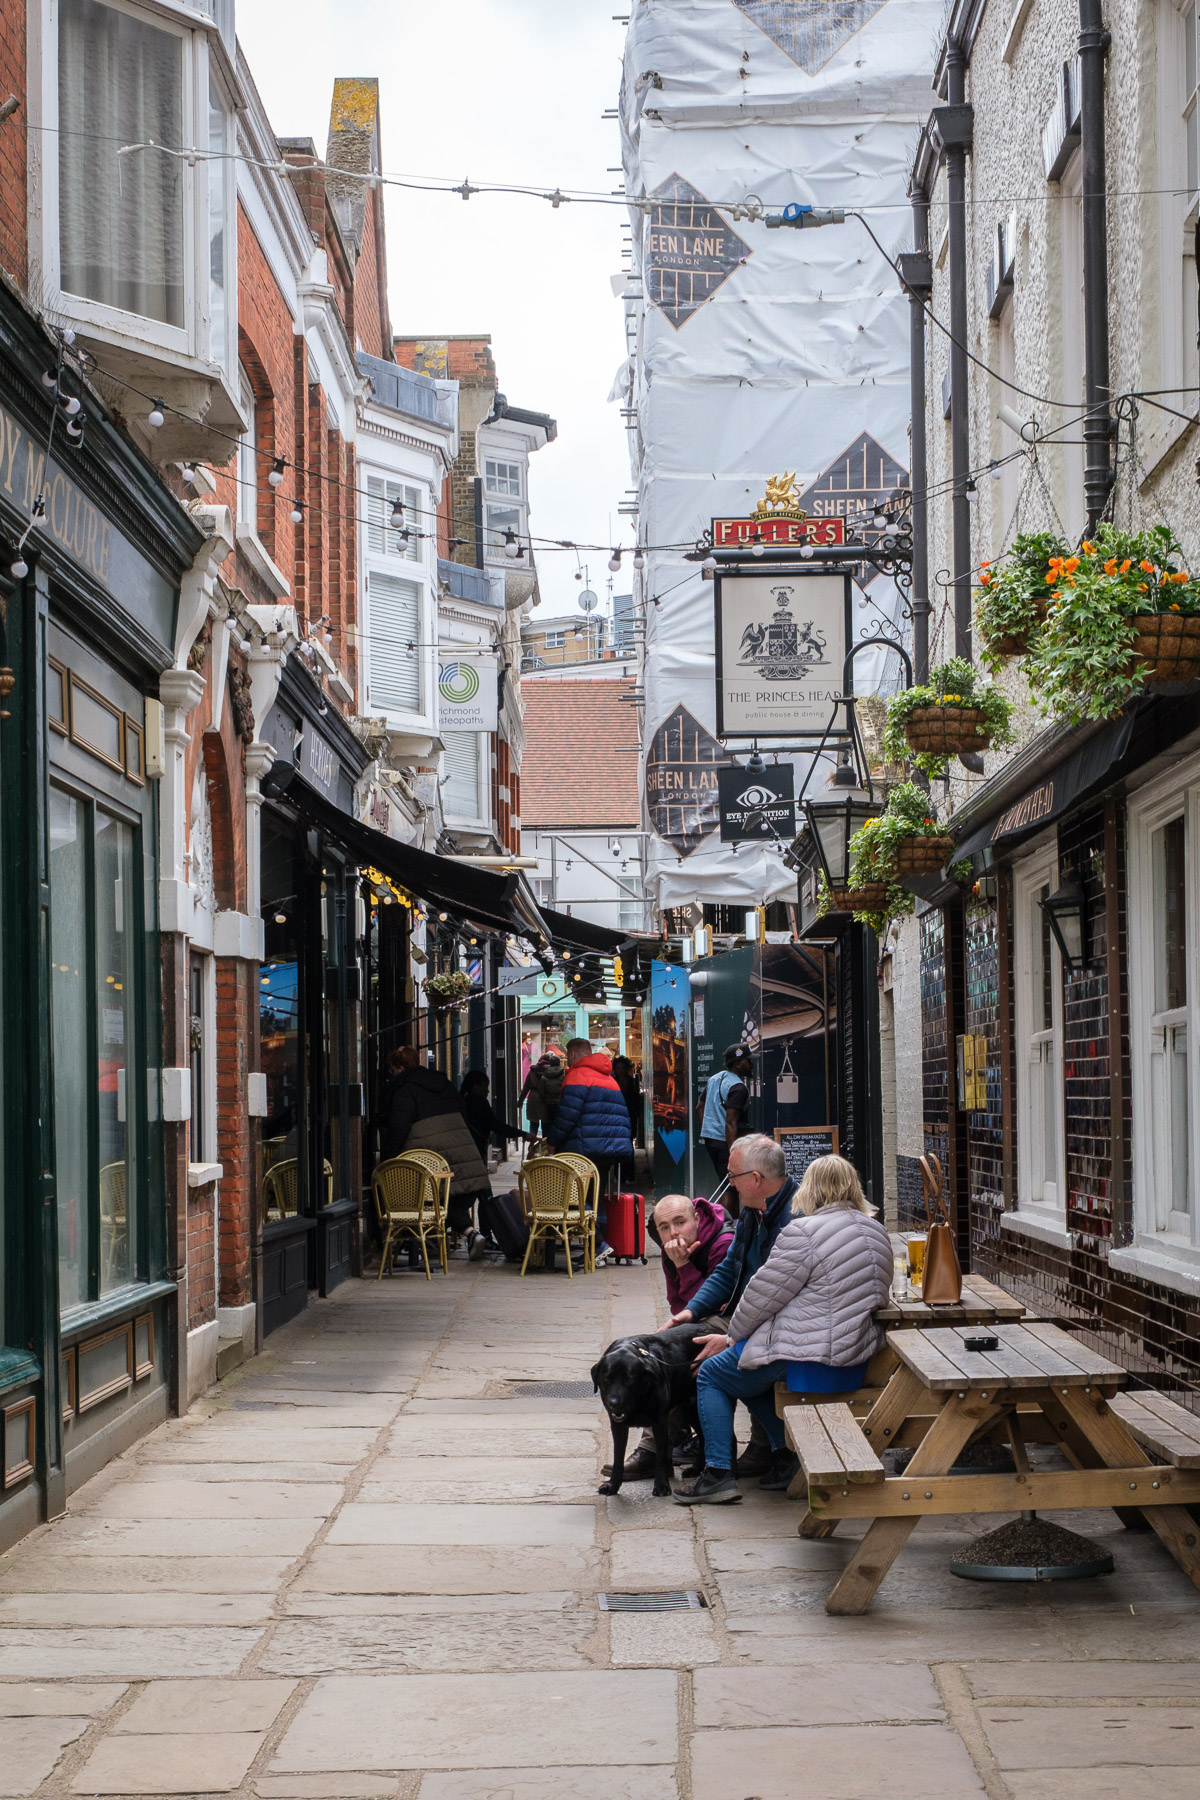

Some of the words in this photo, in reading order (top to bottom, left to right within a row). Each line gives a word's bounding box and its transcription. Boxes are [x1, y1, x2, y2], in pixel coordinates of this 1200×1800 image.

[683, 236, 725, 257] LANE
[654, 256, 700, 265] LONDON
[0, 407, 21, 495] Y
[812, 498, 867, 517] SHEEN
[721, 521, 837, 545] FULLER'S
[727, 692, 751, 703] THE
[756, 691, 805, 702] PRINCES
[808, 690, 842, 701] HEAD
[438, 707, 481, 715] ichmond
[745, 711, 768, 719] public
[801, 711, 825, 719] dining
[438, 716, 484, 725] steopaths
[647, 771, 682, 792] SHEEN
[661, 792, 706, 800] LONDON
[726, 812, 742, 820] EYE
[743, 809, 790, 820] DNITION
